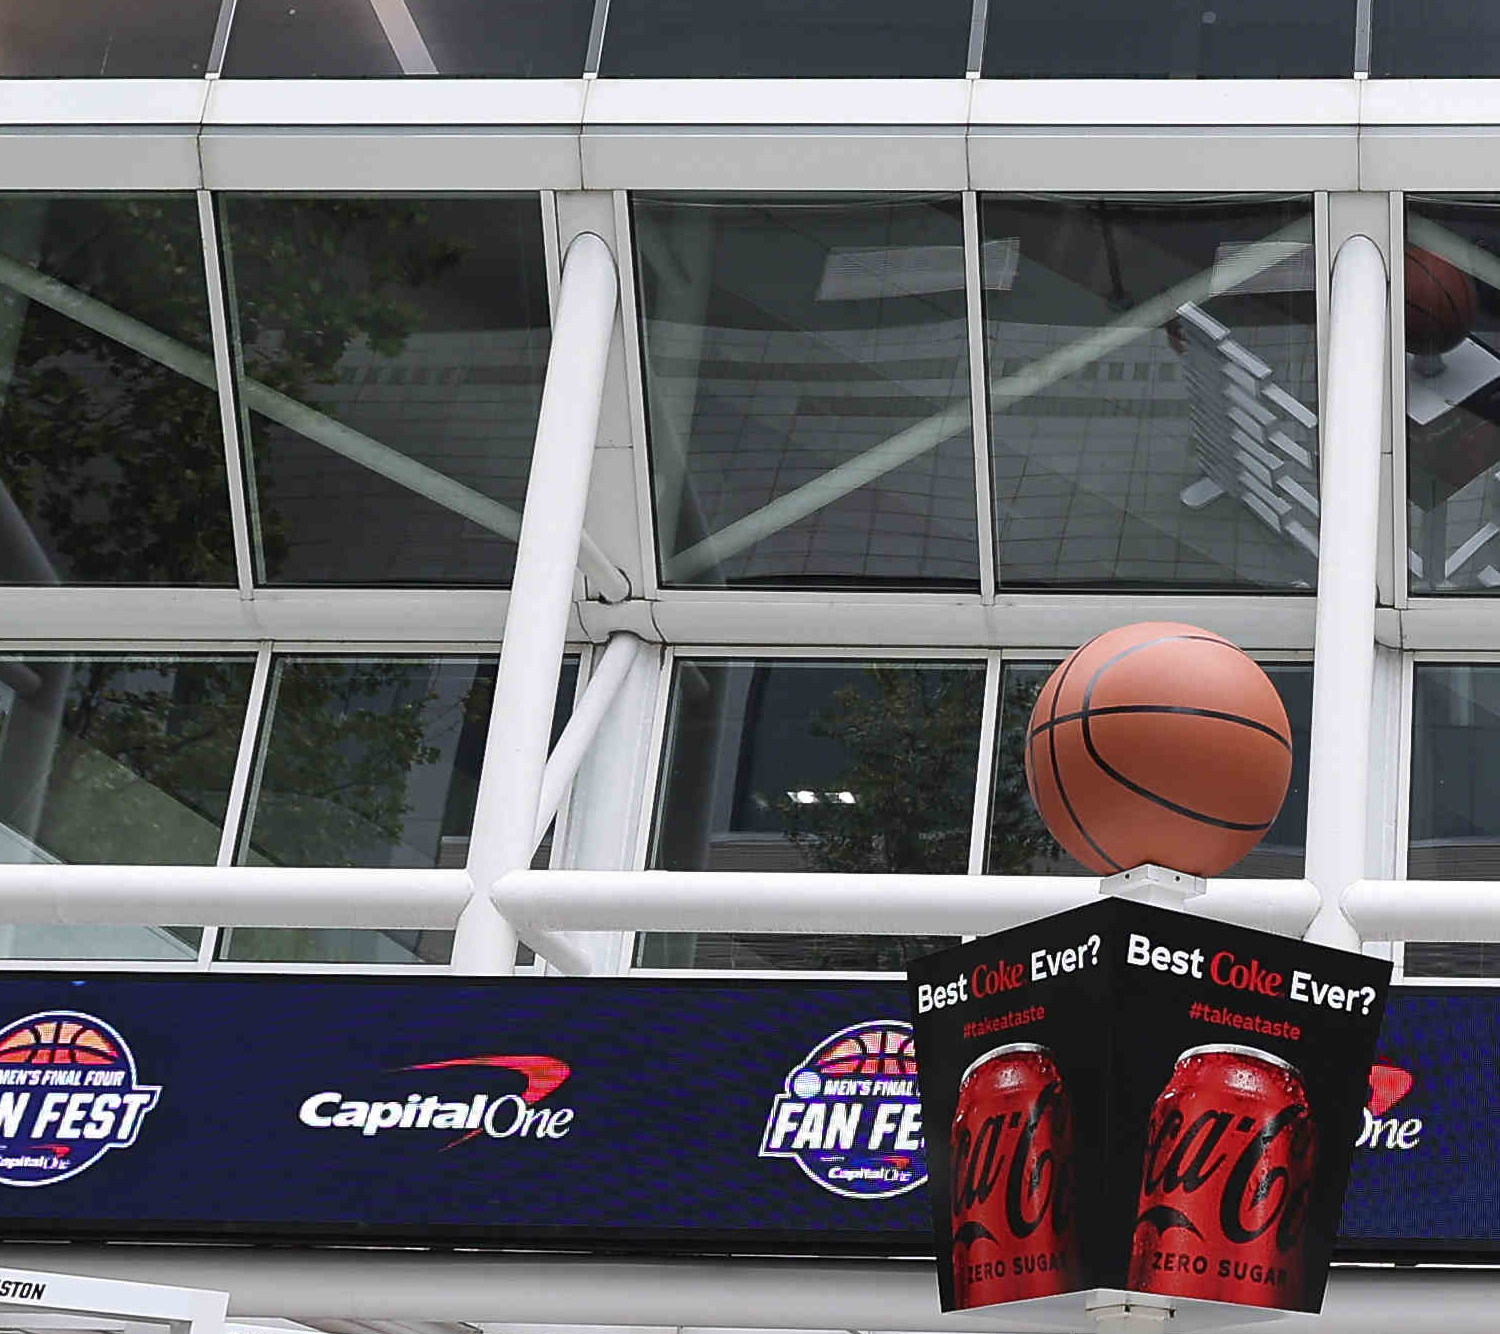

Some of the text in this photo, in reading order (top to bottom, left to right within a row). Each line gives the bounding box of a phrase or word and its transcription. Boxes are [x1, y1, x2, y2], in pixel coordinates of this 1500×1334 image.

[918, 934, 1101, 1014] Best Coke Ever?
[1127, 933, 1376, 1015] Best Coke Ever?
[963, 1005, 1046, 1037] #takeataste
[1190, 1003, 1301, 1040] #takeataste
[41, 1070, 82, 1086] FINAL
[85, 1071, 125, 1086] FOUR
[31, 1093, 151, 1139] FEST
[769, 1103, 924, 1150] FAN FE
[1152, 1251, 1208, 1276] ZERO
